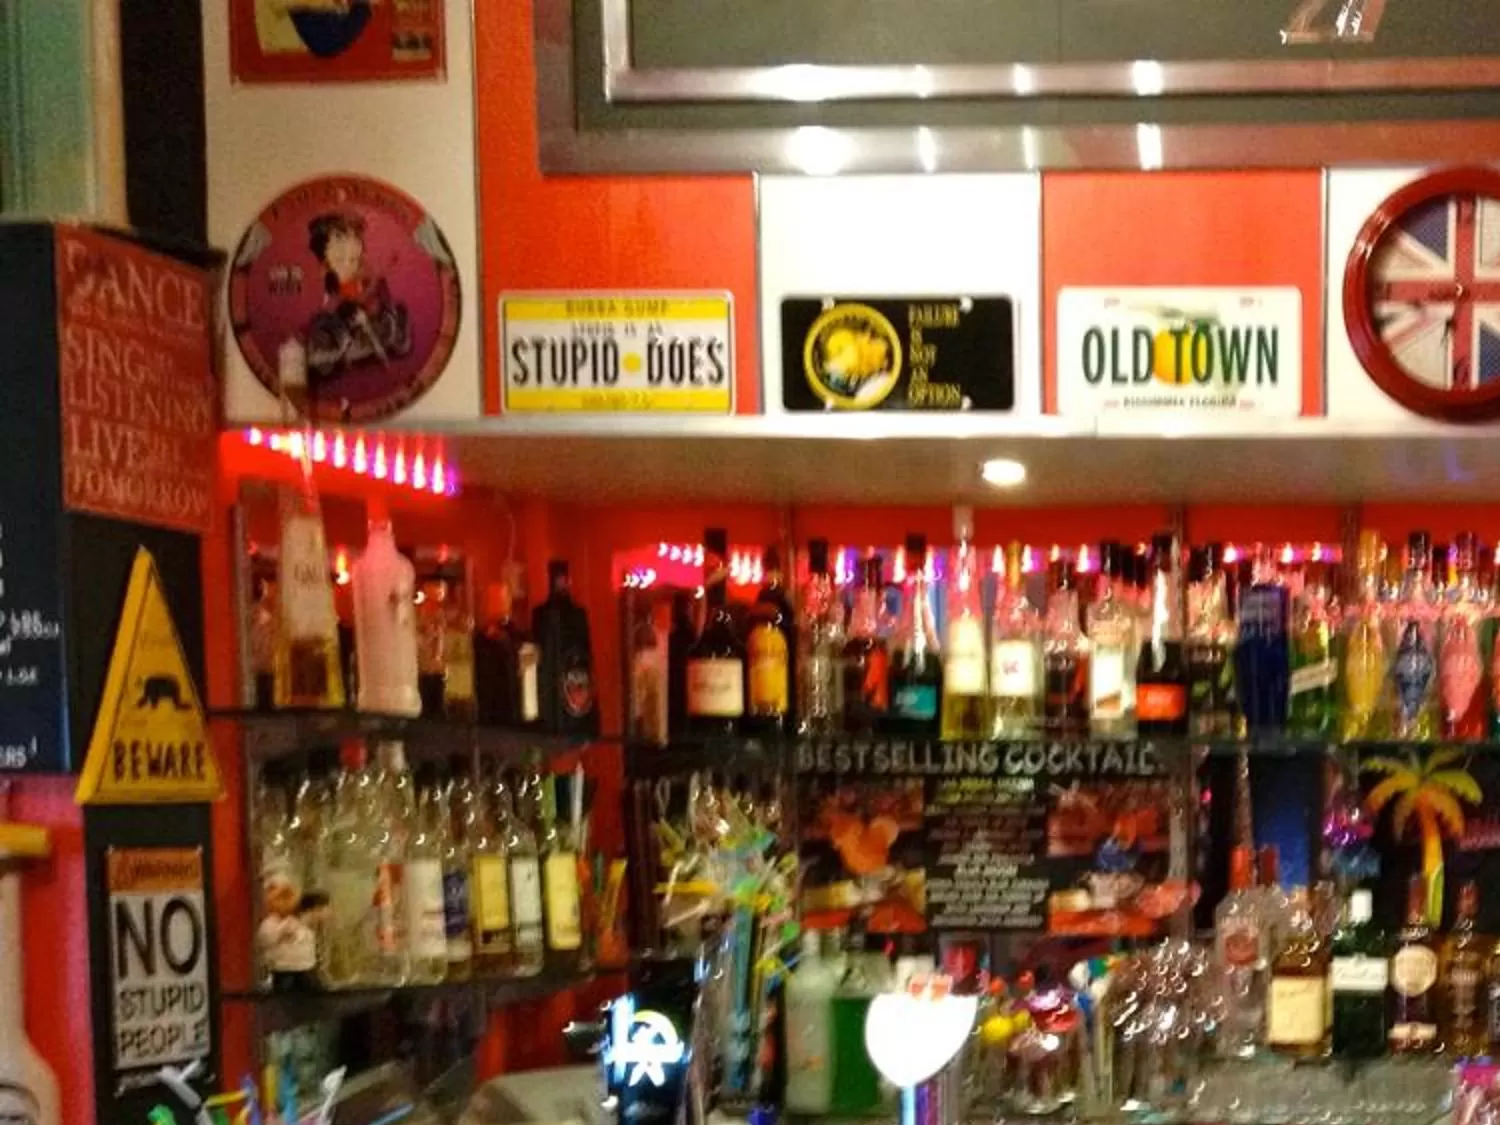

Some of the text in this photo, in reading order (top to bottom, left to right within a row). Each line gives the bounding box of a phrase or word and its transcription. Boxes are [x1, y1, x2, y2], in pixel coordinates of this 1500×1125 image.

[511, 334, 724, 388] STUPID DOES
[1081, 325, 1279, 386] OLD TOWN
[908, 384, 961, 407] OPTION
[114, 741, 207, 784] BEWARE
[799, 740, 999, 774] BESTSELLING
[115, 896, 202, 980] NO
[119, 980, 205, 1022] STUPID
[119, 1017, 208, 1058] PEOPLE
